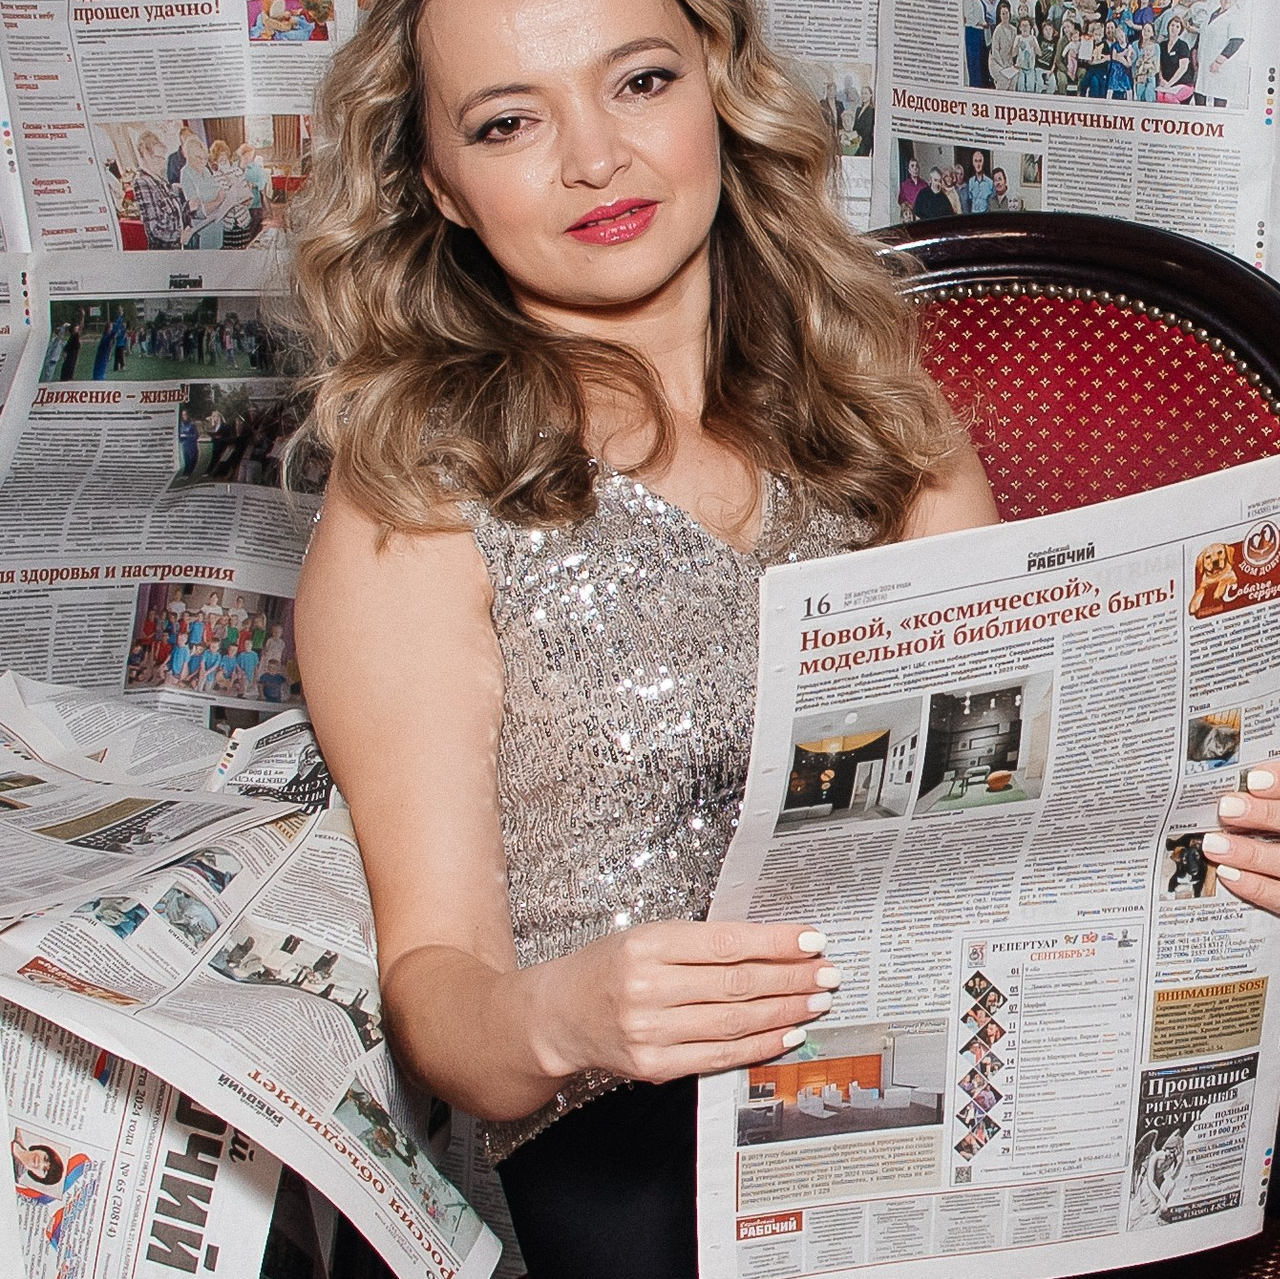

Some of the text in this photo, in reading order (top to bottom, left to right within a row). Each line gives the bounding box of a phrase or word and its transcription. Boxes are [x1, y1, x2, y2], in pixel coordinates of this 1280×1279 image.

[74, 5, 140, 24] прошел
[892, 88, 1225, 139] Медсовет за праздничным столом
[32, 382, 189, 407] Движение жизнь!
[19, 563, 235, 587] здоровья и настроения
[800, 576, 1100, 653] Новой, «космической»,
[803, 593, 831, 618] 16
[798, 579, 1177, 677] модельной библиотеке быть!
[992, 938, 1058, 953] РЕПЕРТУАР
[1157, 980, 1265, 1003] ВНИМАНИЕ! SOS!
[1147, 1067, 1250, 1097] Прощание
[1145, 1088, 1238, 1115] РИТУАЛЬНЫЕ
[247, 1068, 386, 1195] объединяет
[1144, 1111, 1200, 1128] УСЛУГИ
